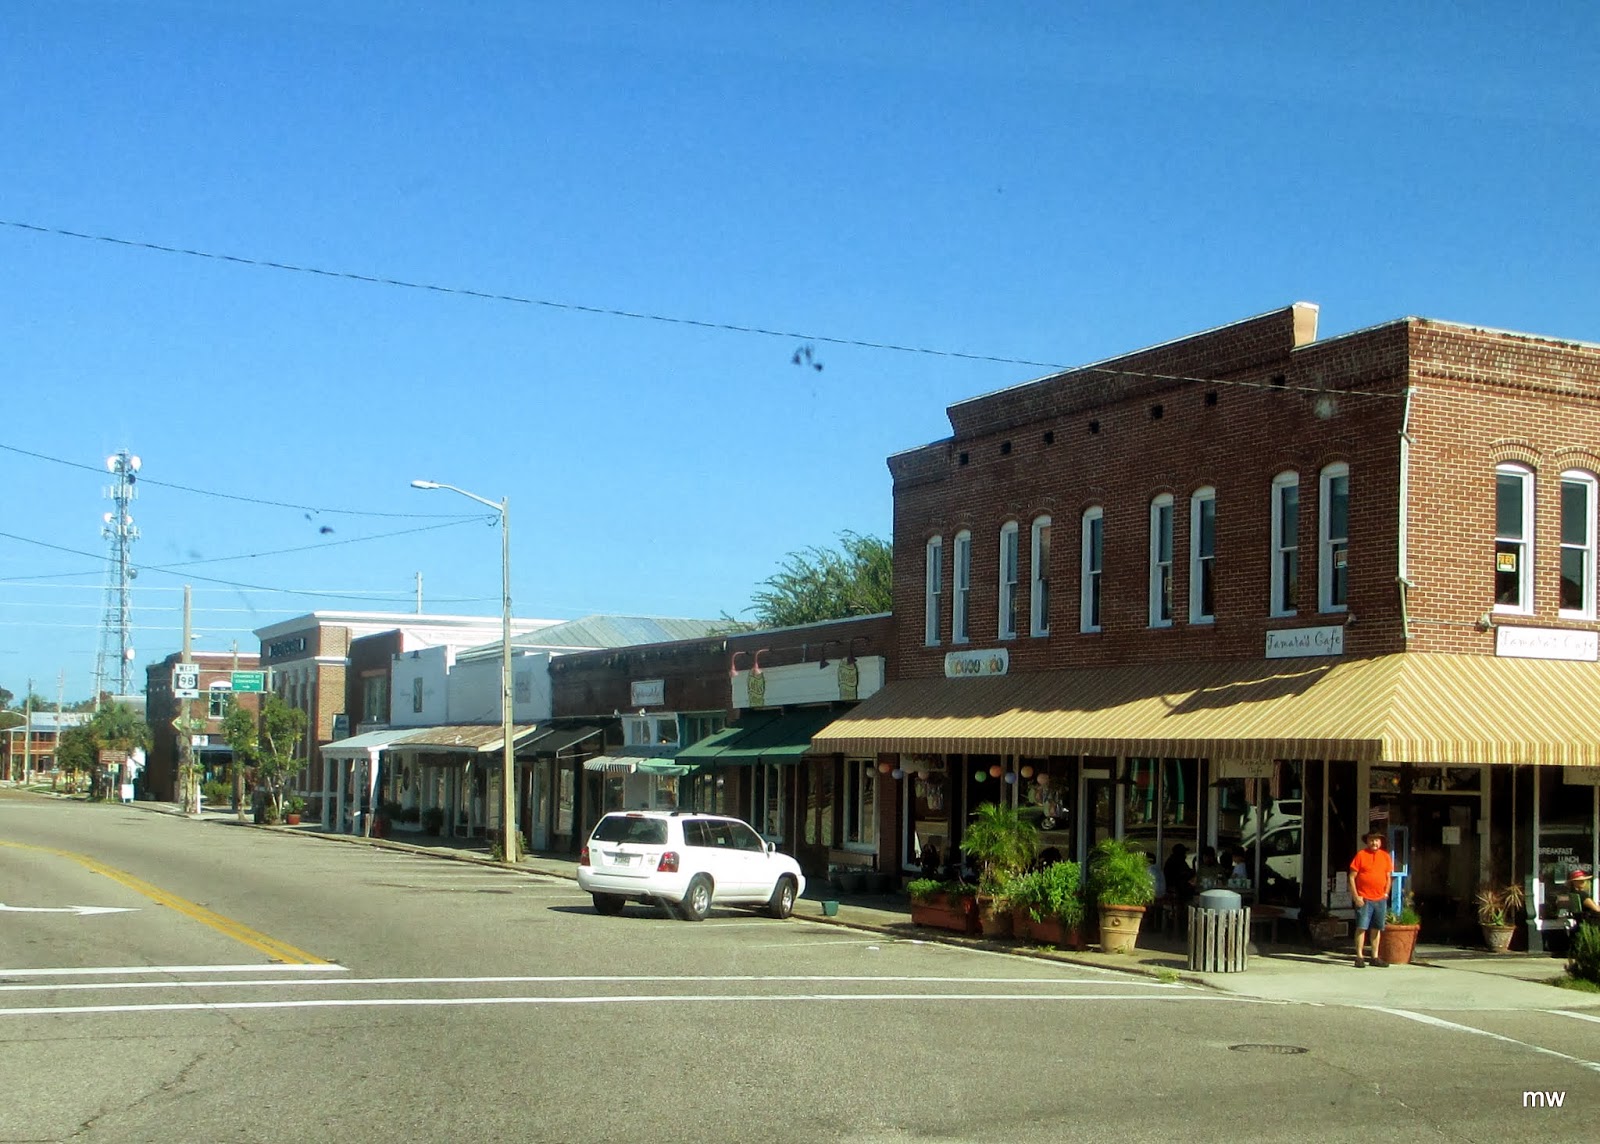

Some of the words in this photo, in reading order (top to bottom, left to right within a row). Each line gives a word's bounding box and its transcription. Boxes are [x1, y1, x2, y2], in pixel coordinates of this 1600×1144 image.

[180, 676, 194, 686] 98
[1539, 847, 1574, 855] BREAKFAST
[1557, 855, 1579, 863] LUNCH
[1568, 863, 1592, 872] DINNER
